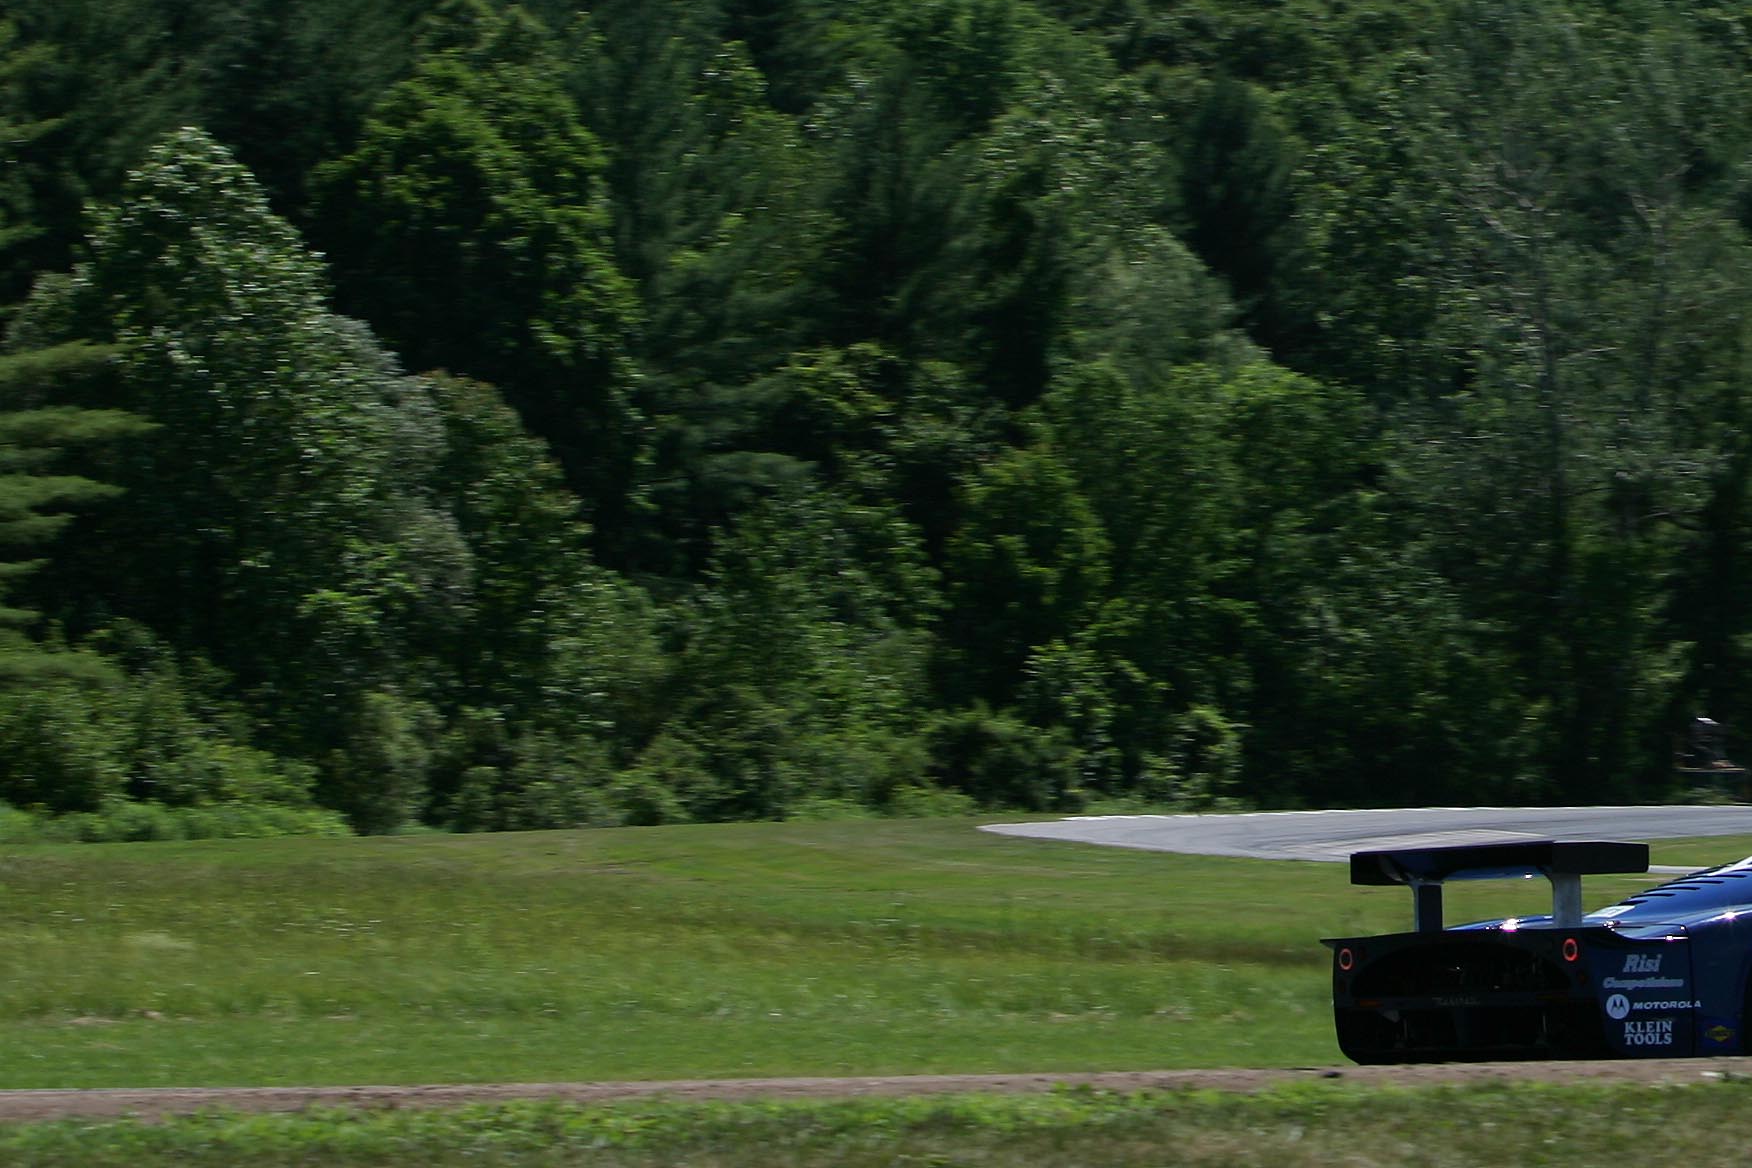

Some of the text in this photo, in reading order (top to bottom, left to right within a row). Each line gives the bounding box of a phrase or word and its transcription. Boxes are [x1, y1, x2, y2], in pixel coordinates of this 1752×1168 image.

[1622, 953, 1663, 973] Risi
[1631, 1000, 1702, 1010] MOTOROLA
[1624, 1021, 1672, 1034] KLEIN
[1624, 1034, 1672, 1045] TOOLS
